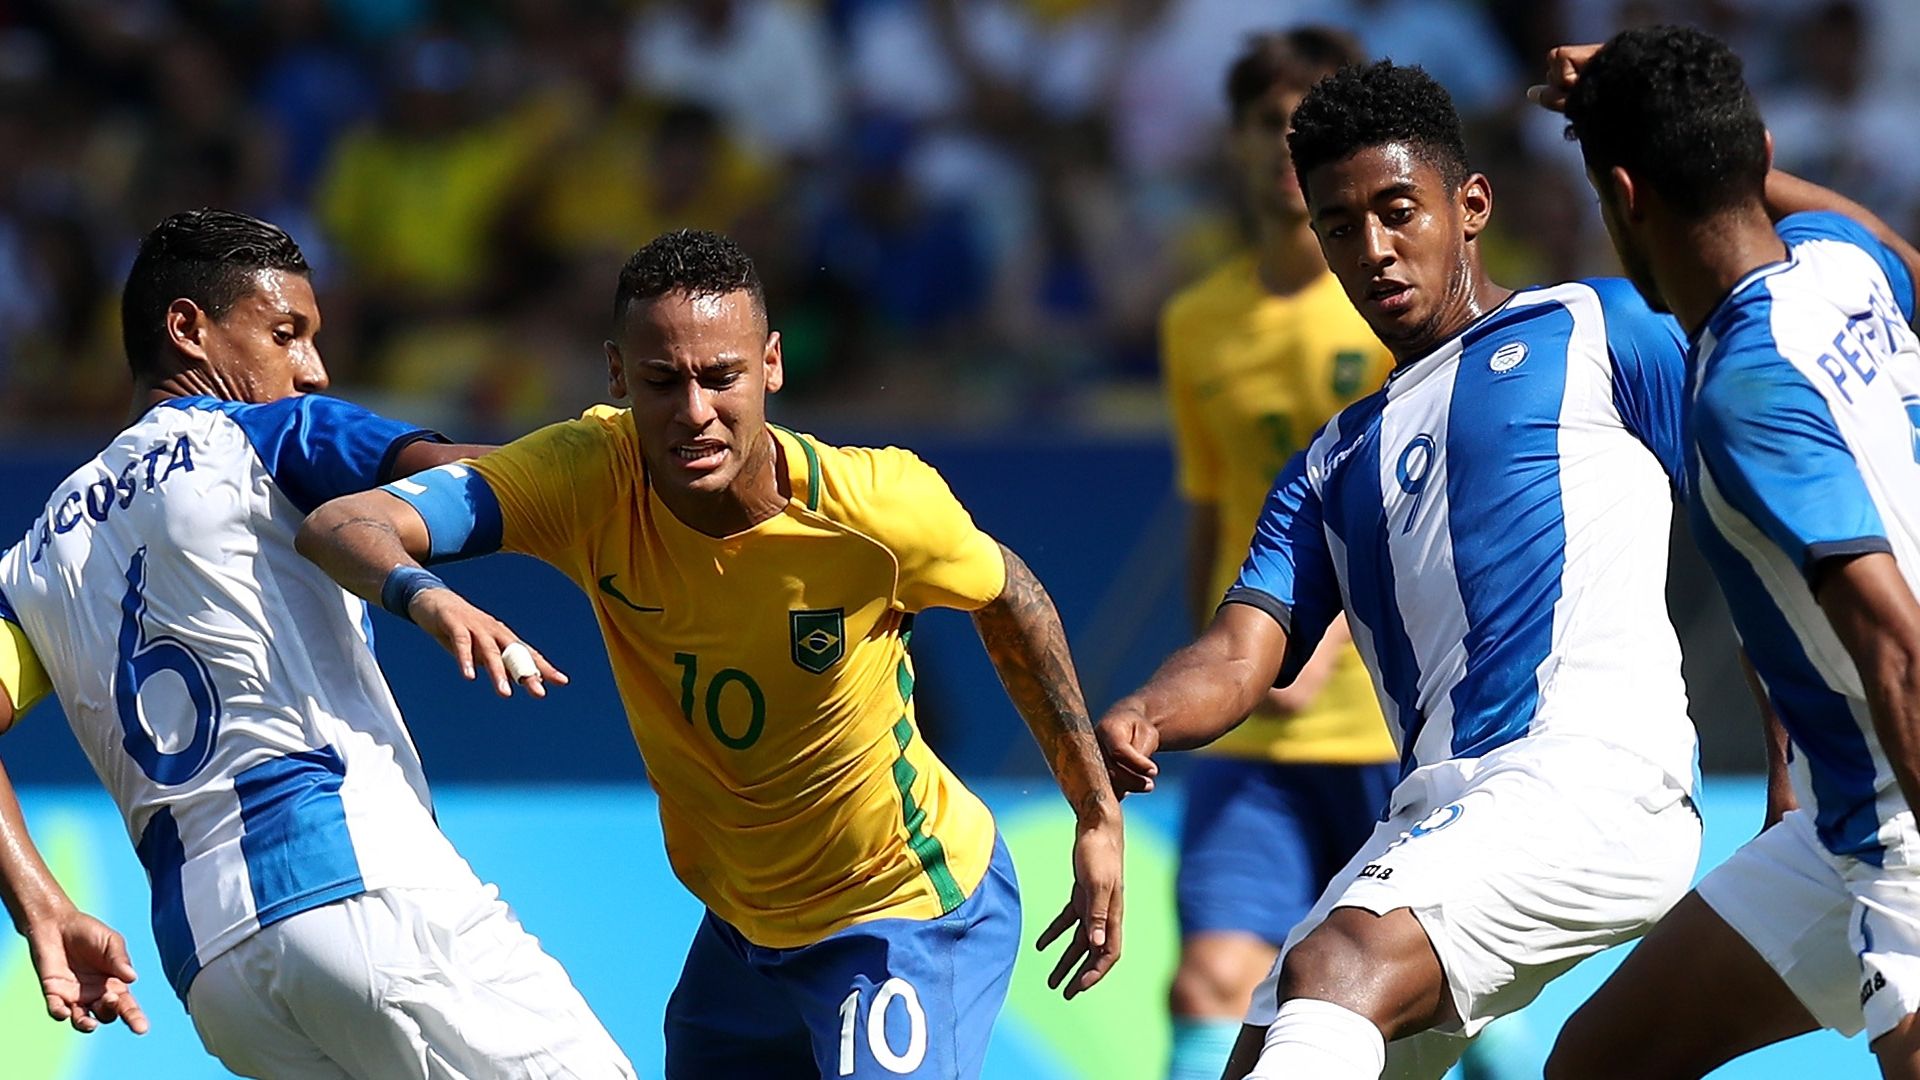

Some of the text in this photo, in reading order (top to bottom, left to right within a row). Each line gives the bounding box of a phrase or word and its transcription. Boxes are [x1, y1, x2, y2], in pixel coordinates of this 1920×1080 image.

[31, 435, 195, 563] ACOSTA
[1396, 433, 1436, 536] 9
[116, 545, 222, 785] 6
[674, 652, 766, 750] 10
[839, 977, 928, 1077] 10
